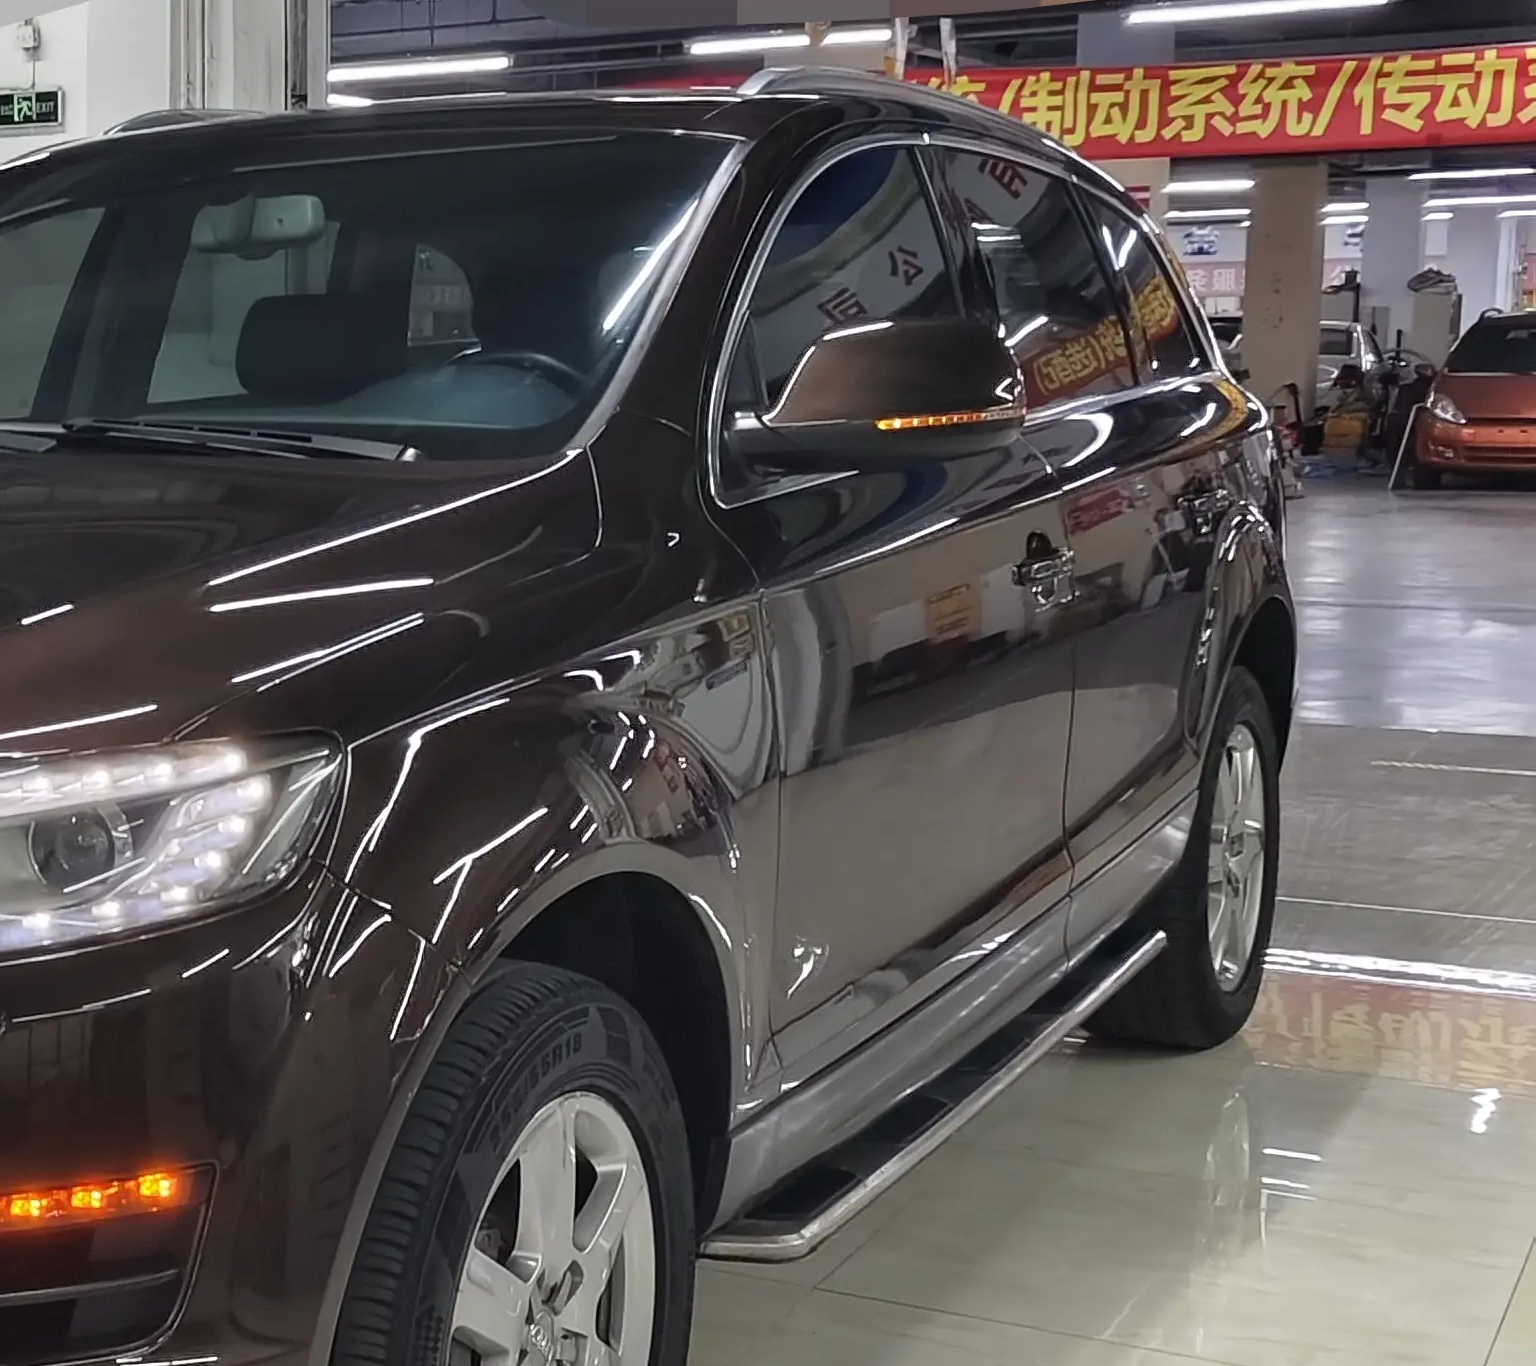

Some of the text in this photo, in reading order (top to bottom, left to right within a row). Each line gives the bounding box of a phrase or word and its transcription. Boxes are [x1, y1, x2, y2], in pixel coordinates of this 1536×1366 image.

[36, 101, 55, 113] EXIT
[927, 48, 1536, 145] /制动系统/传动
